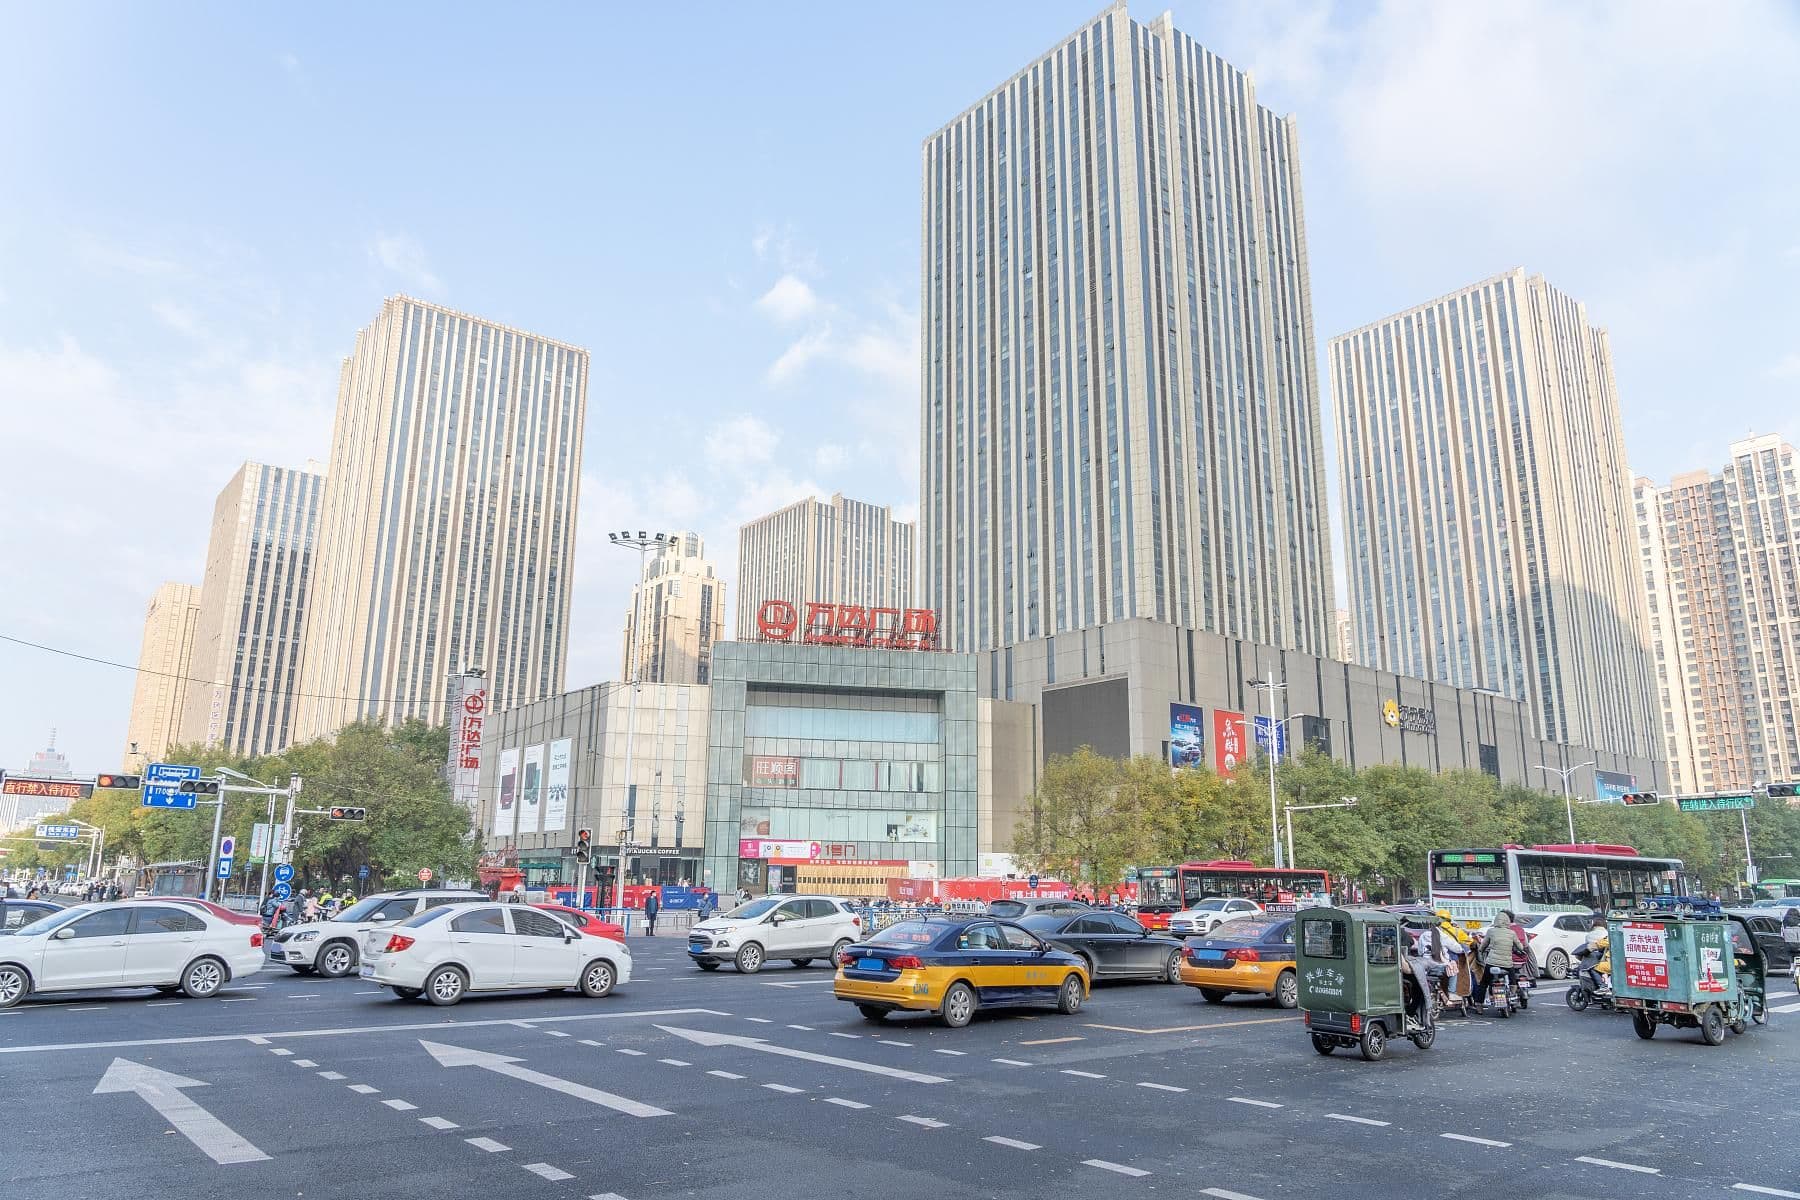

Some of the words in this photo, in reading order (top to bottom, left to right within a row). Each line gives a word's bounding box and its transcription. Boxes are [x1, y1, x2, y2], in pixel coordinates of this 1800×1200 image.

[805, 602, 937, 633] 万达广场
[464, 717, 482, 769] 万达广场
[4, 782, 81, 797] 直行禁入待行区
[825, 844, 856, 857] 1号门
[1629, 934, 1660, 944] 京东快递
[1626, 944, 1664, 954] 招聘配送员
